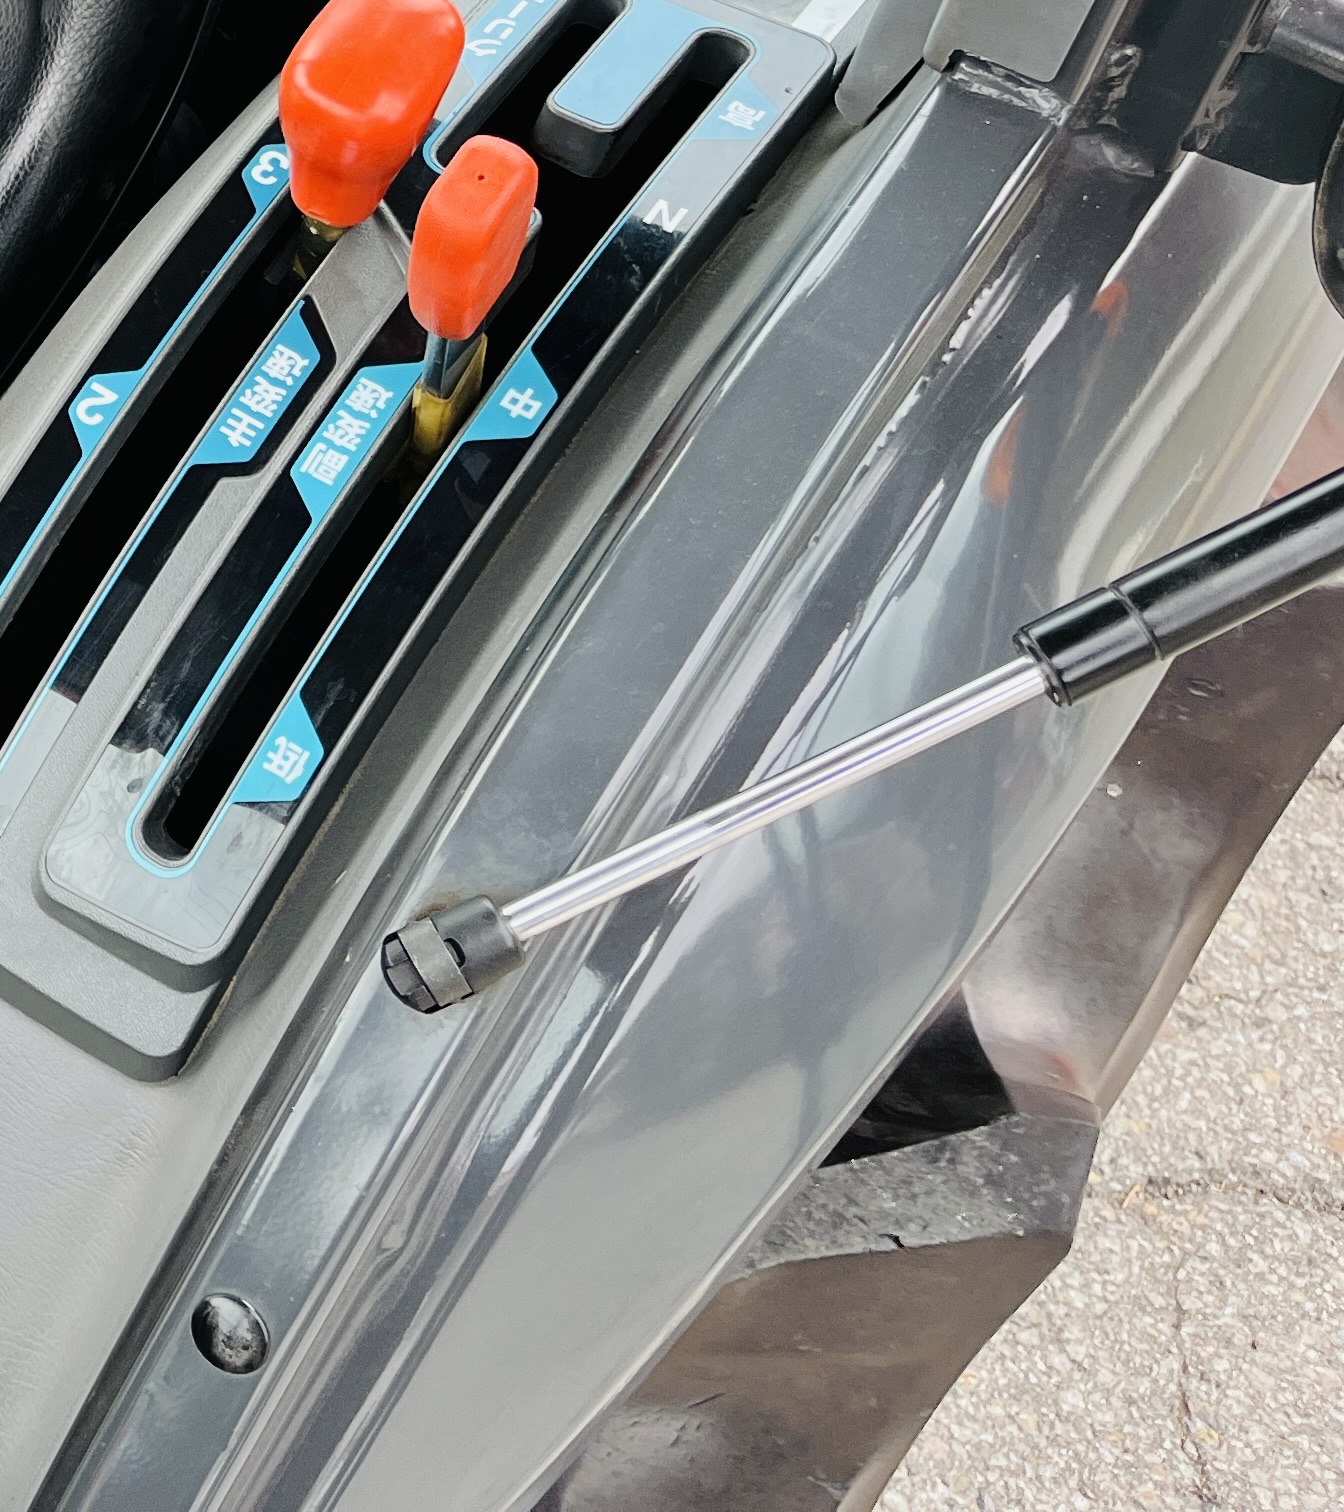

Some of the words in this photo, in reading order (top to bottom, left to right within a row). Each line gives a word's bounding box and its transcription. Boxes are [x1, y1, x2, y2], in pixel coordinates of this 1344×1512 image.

[726, 99, 768, 129] 高
[252, 150, 289, 186] 3
[642, 197, 687, 234] N
[79, 380, 118, 427] 2
[220, 343, 310, 449] 主変速
[505, 387, 546, 421] 中
[300, 365, 396, 487] 副変速
[263, 735, 313, 784] 低
